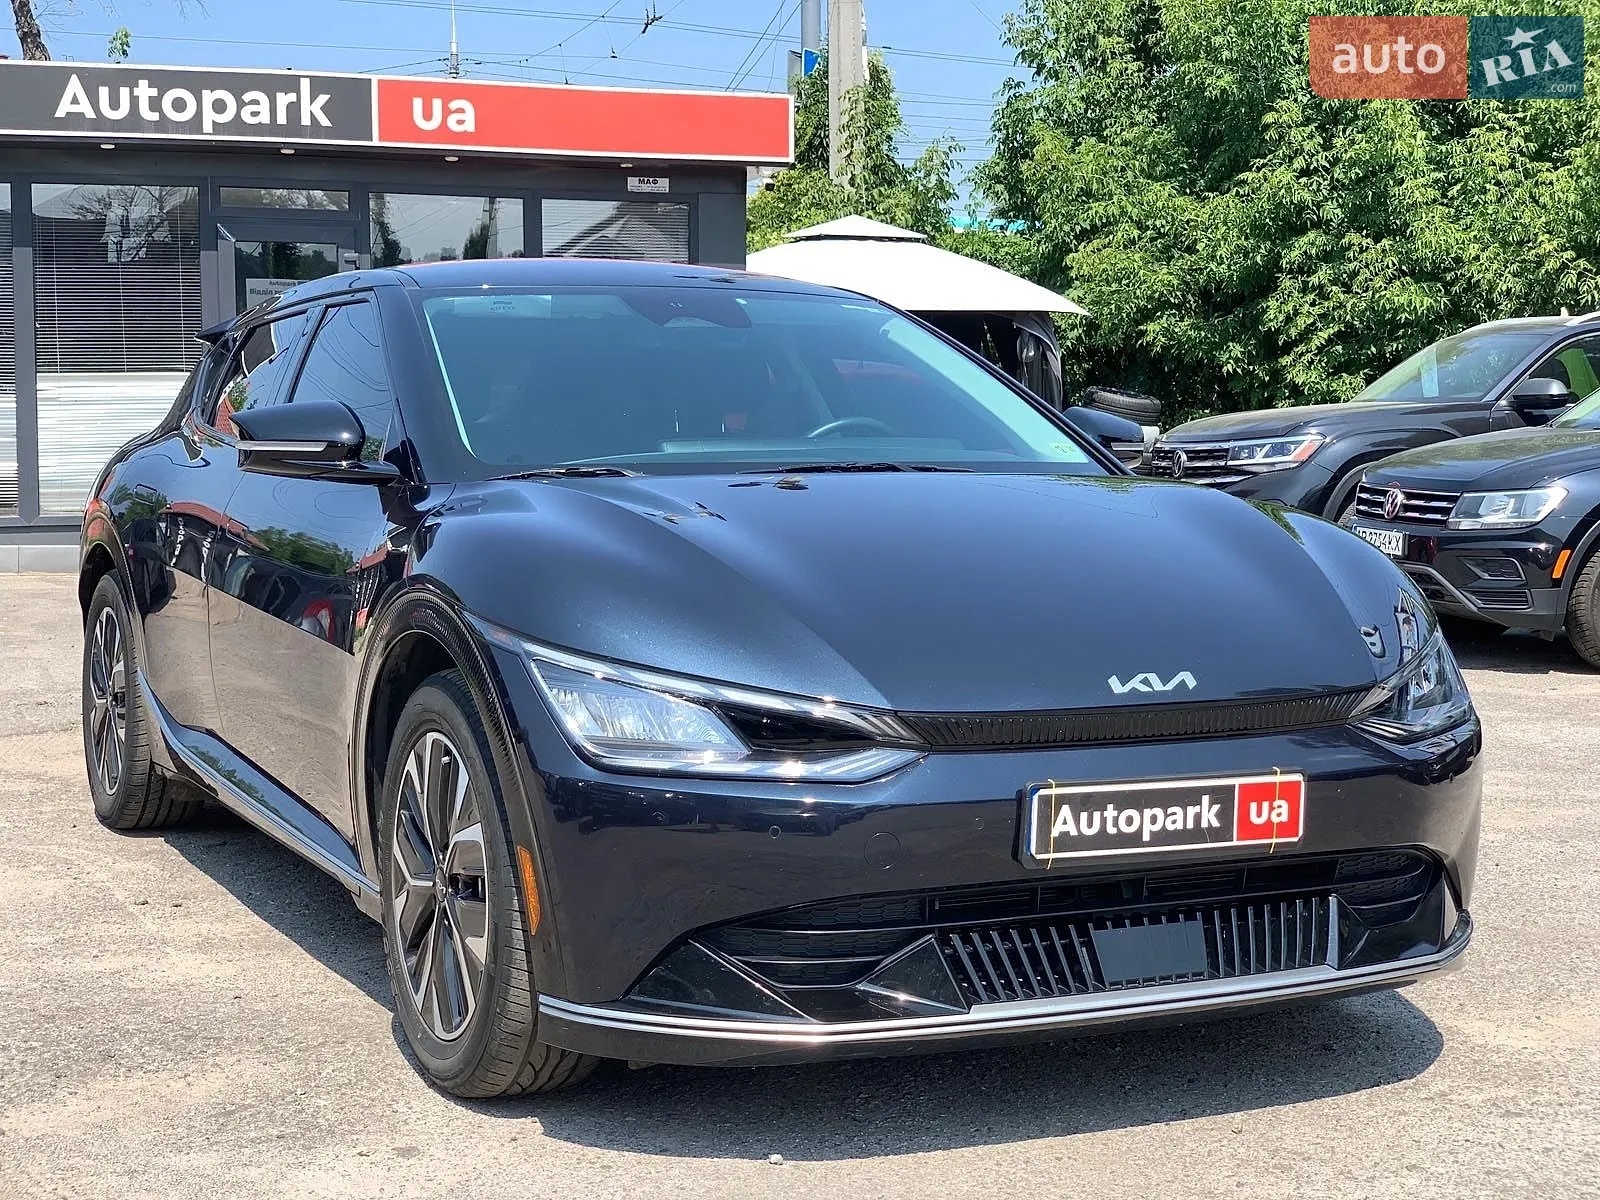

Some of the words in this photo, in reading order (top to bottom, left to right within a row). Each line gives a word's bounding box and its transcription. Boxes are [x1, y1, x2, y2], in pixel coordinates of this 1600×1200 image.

[54, 73, 333, 134] Autopark
[412, 97, 476, 133] ua
[1052, 795, 1221, 842] Autopark
[1249, 799, 1289, 825] ua
